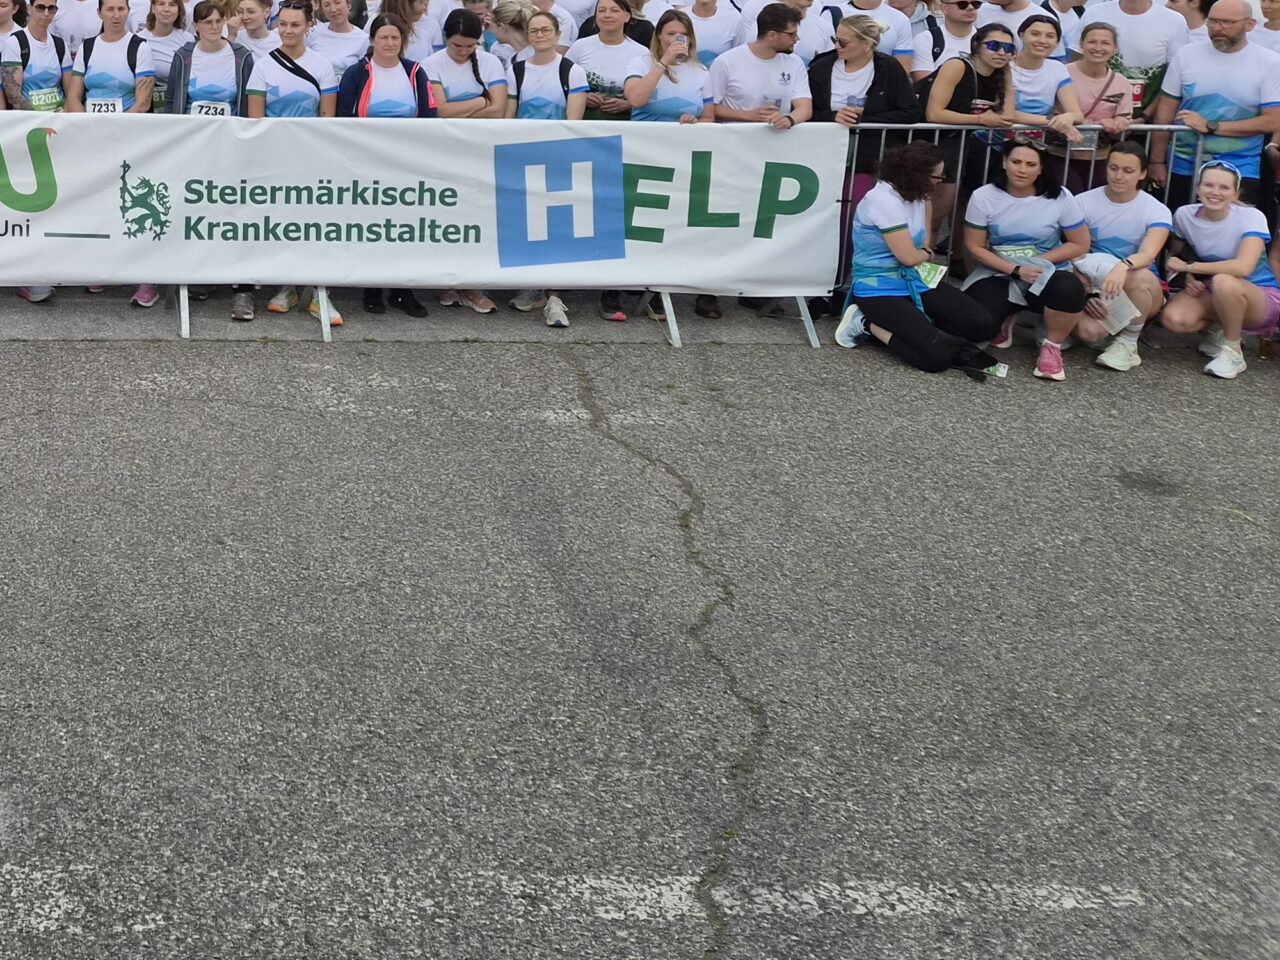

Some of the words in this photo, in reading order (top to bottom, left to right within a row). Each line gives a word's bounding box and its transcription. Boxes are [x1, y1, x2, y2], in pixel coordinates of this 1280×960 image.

[91, 103, 117, 113] 7233
[198, 104, 225, 116] 7234
[183, 179, 459, 207] Steiermärkische
[524, 150, 821, 244] HELP
[183, 215, 482, 244] Krankenanstalten
